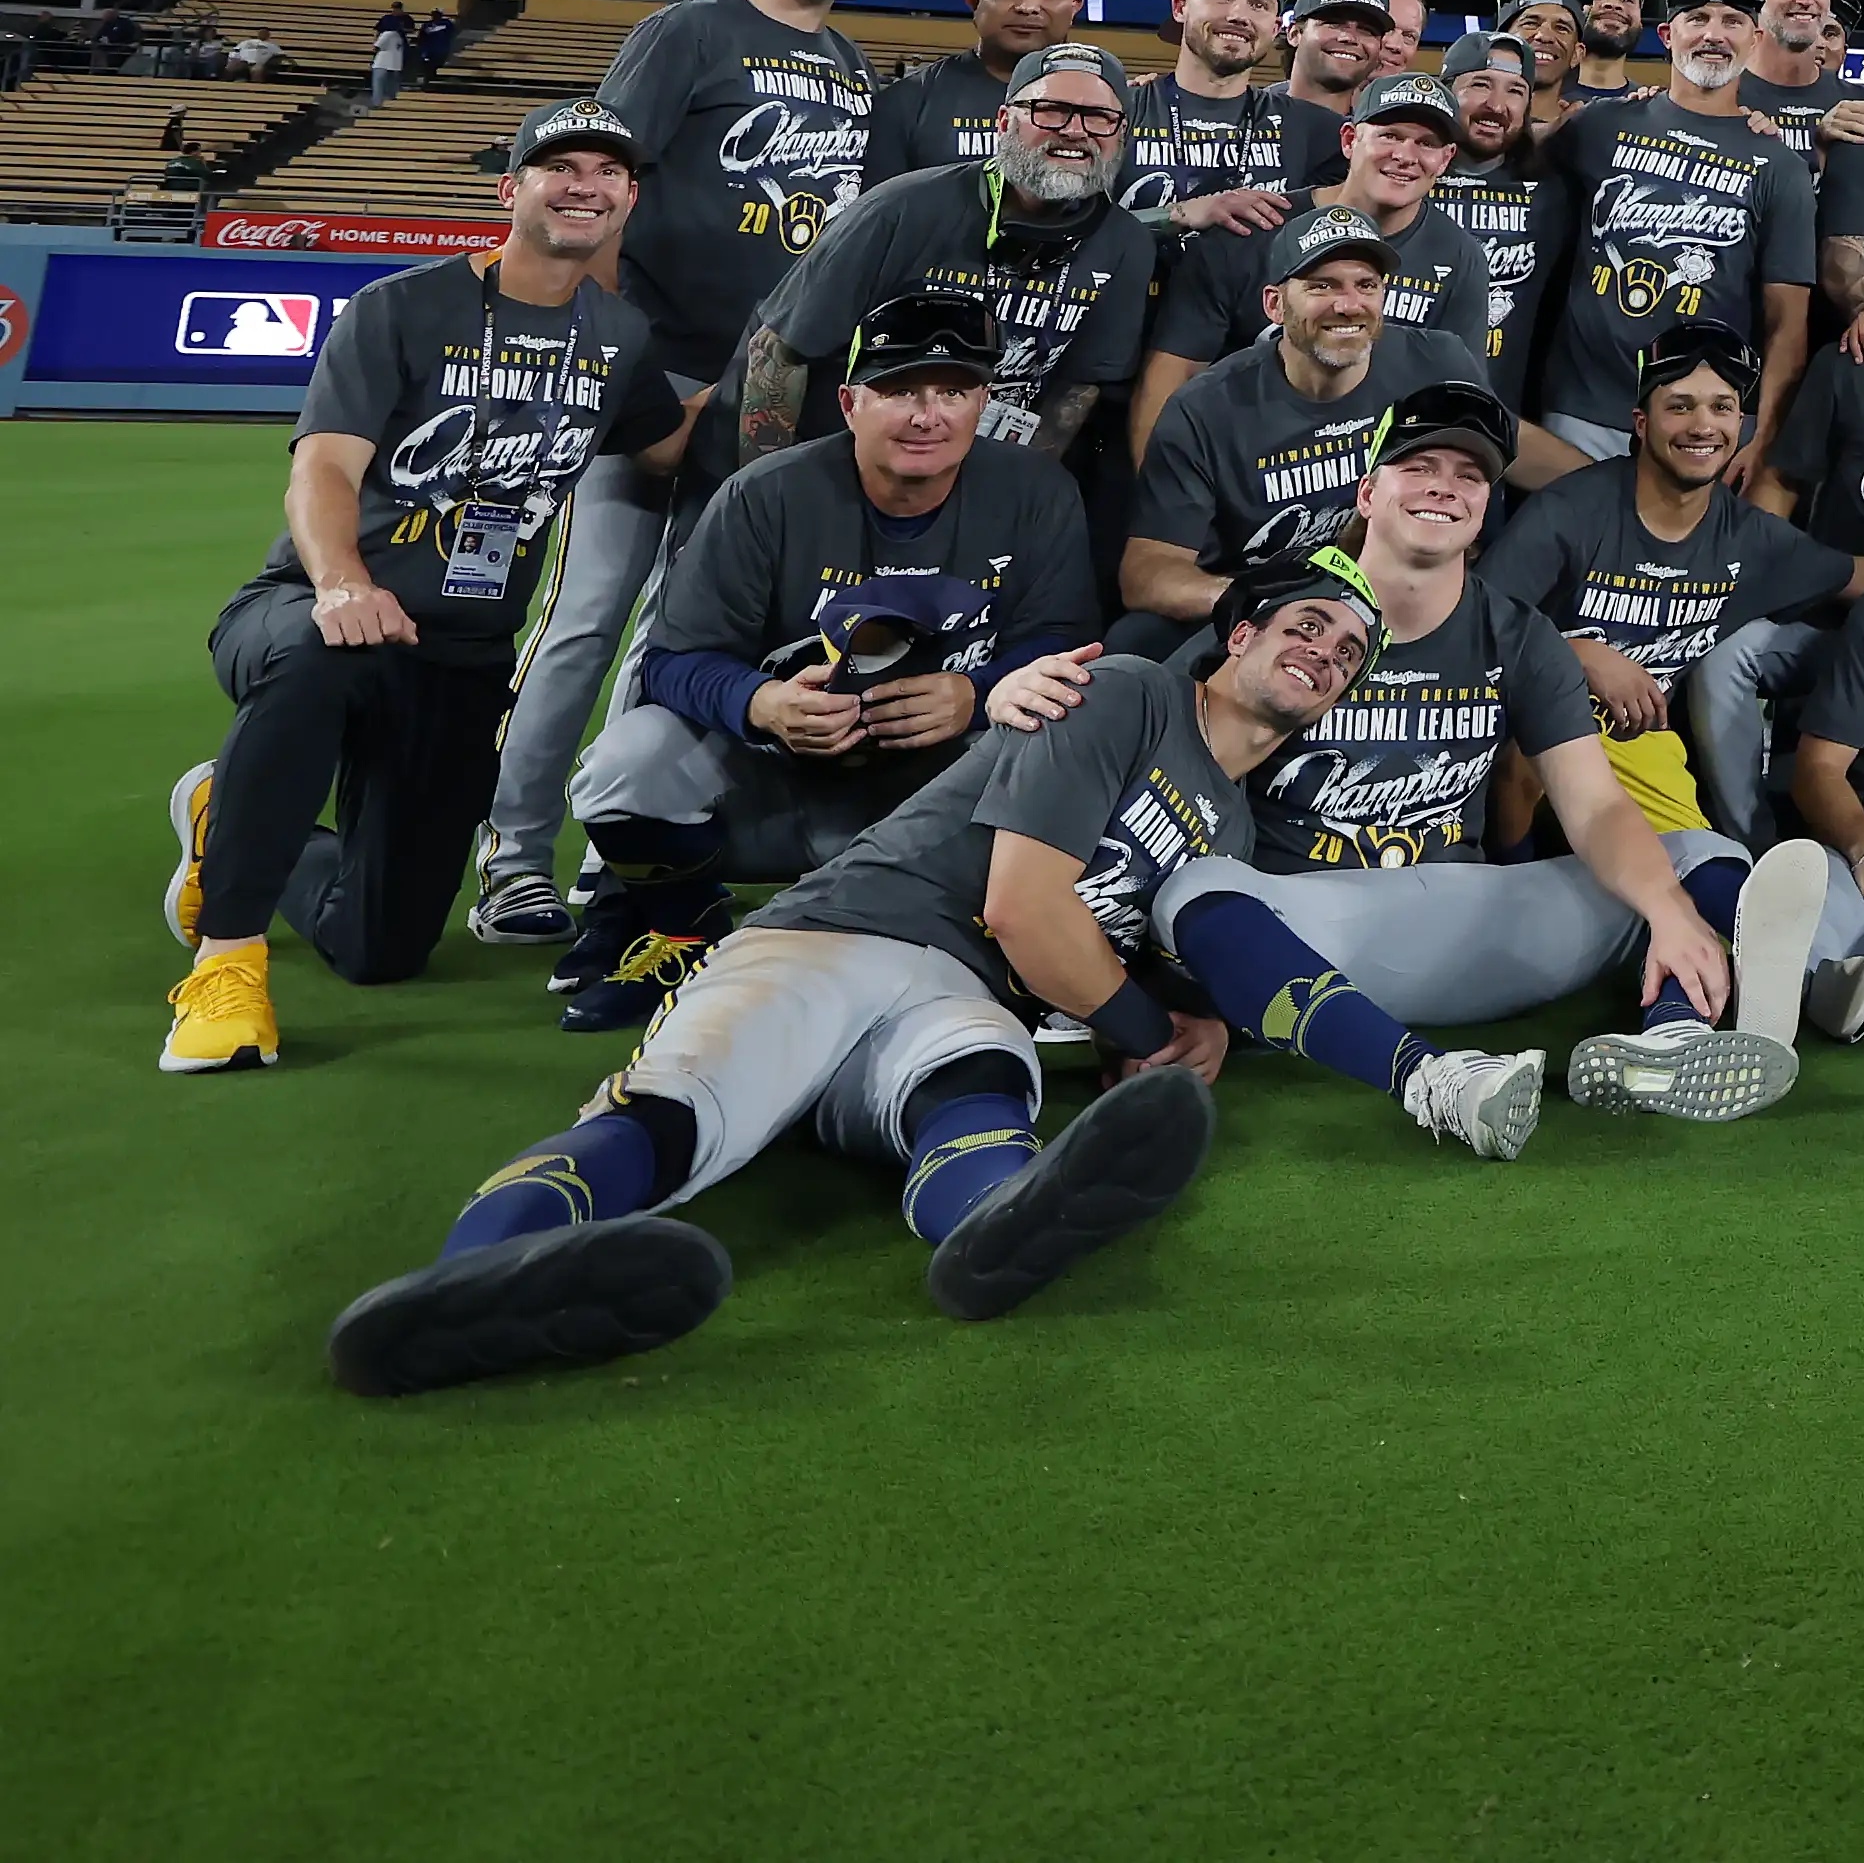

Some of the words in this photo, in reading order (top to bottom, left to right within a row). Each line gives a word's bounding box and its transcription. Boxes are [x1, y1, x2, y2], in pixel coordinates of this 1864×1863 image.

[751, 69, 828, 103] NATIONAL
[1612, 144, 1691, 185] NATIONAL
[1693, 161, 1753, 198] LEAGUE
[738, 202, 769, 235] 20
[1471, 208, 1531, 232] LEAGUE
[1592, 173, 1747, 249] Champions
[330, 229, 388, 245] HOME
[393, 232, 433, 245] RUN
[437, 235, 500, 248] MAGIC
[1675, 286, 1702, 316] 26
[1263, 455, 1360, 503] NATIONAL
[1579, 588, 1660, 627] NATIONAL
[1667, 595, 1729, 627] LEAGUE
[1303, 709, 1412, 743] NATIONAL
[1416, 705, 1502, 742] LEAGUE
[1267, 743, 1499, 828] Champions
[1308, 837, 1343, 863] 20
